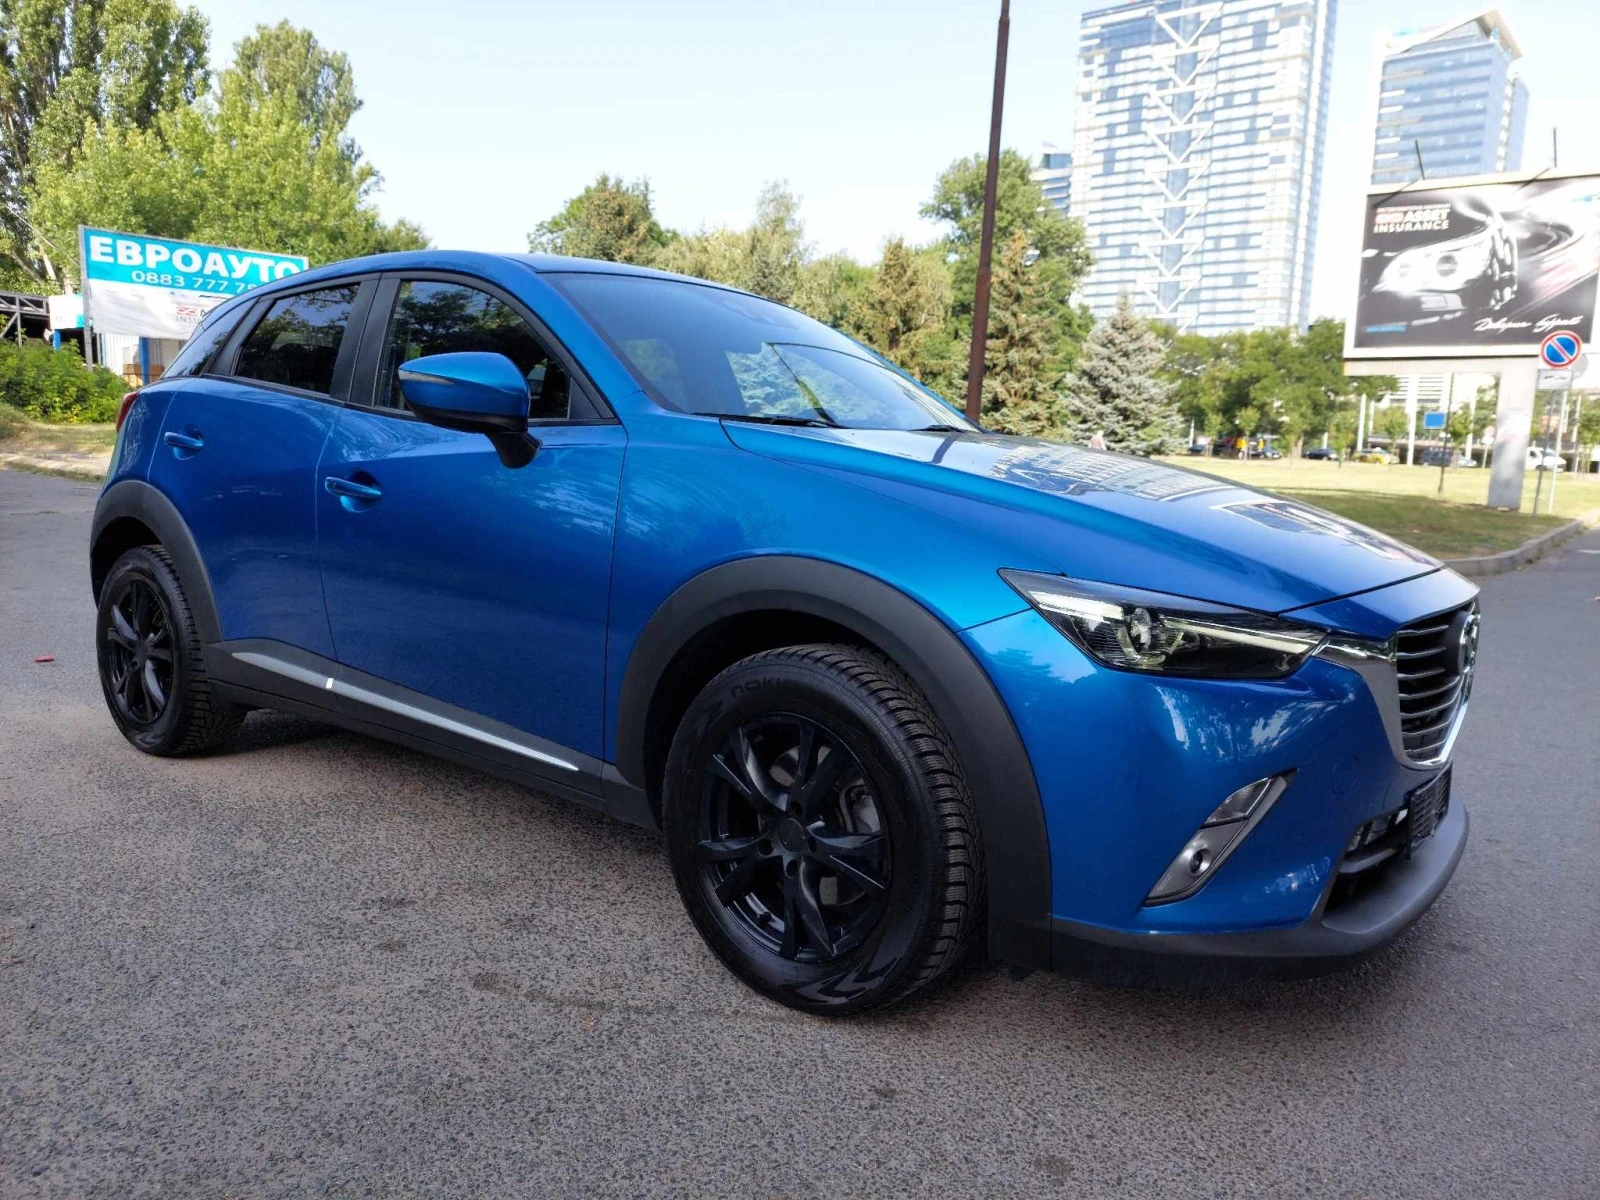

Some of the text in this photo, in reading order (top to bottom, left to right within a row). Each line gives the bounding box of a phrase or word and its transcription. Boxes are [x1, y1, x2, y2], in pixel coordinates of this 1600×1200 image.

[1373, 219, 1450, 233] INSURANCE
[89, 235, 300, 283] ЕВРОАУТО
[131, 270, 186, 287] 0883
[192, 277, 228, 292] 777
